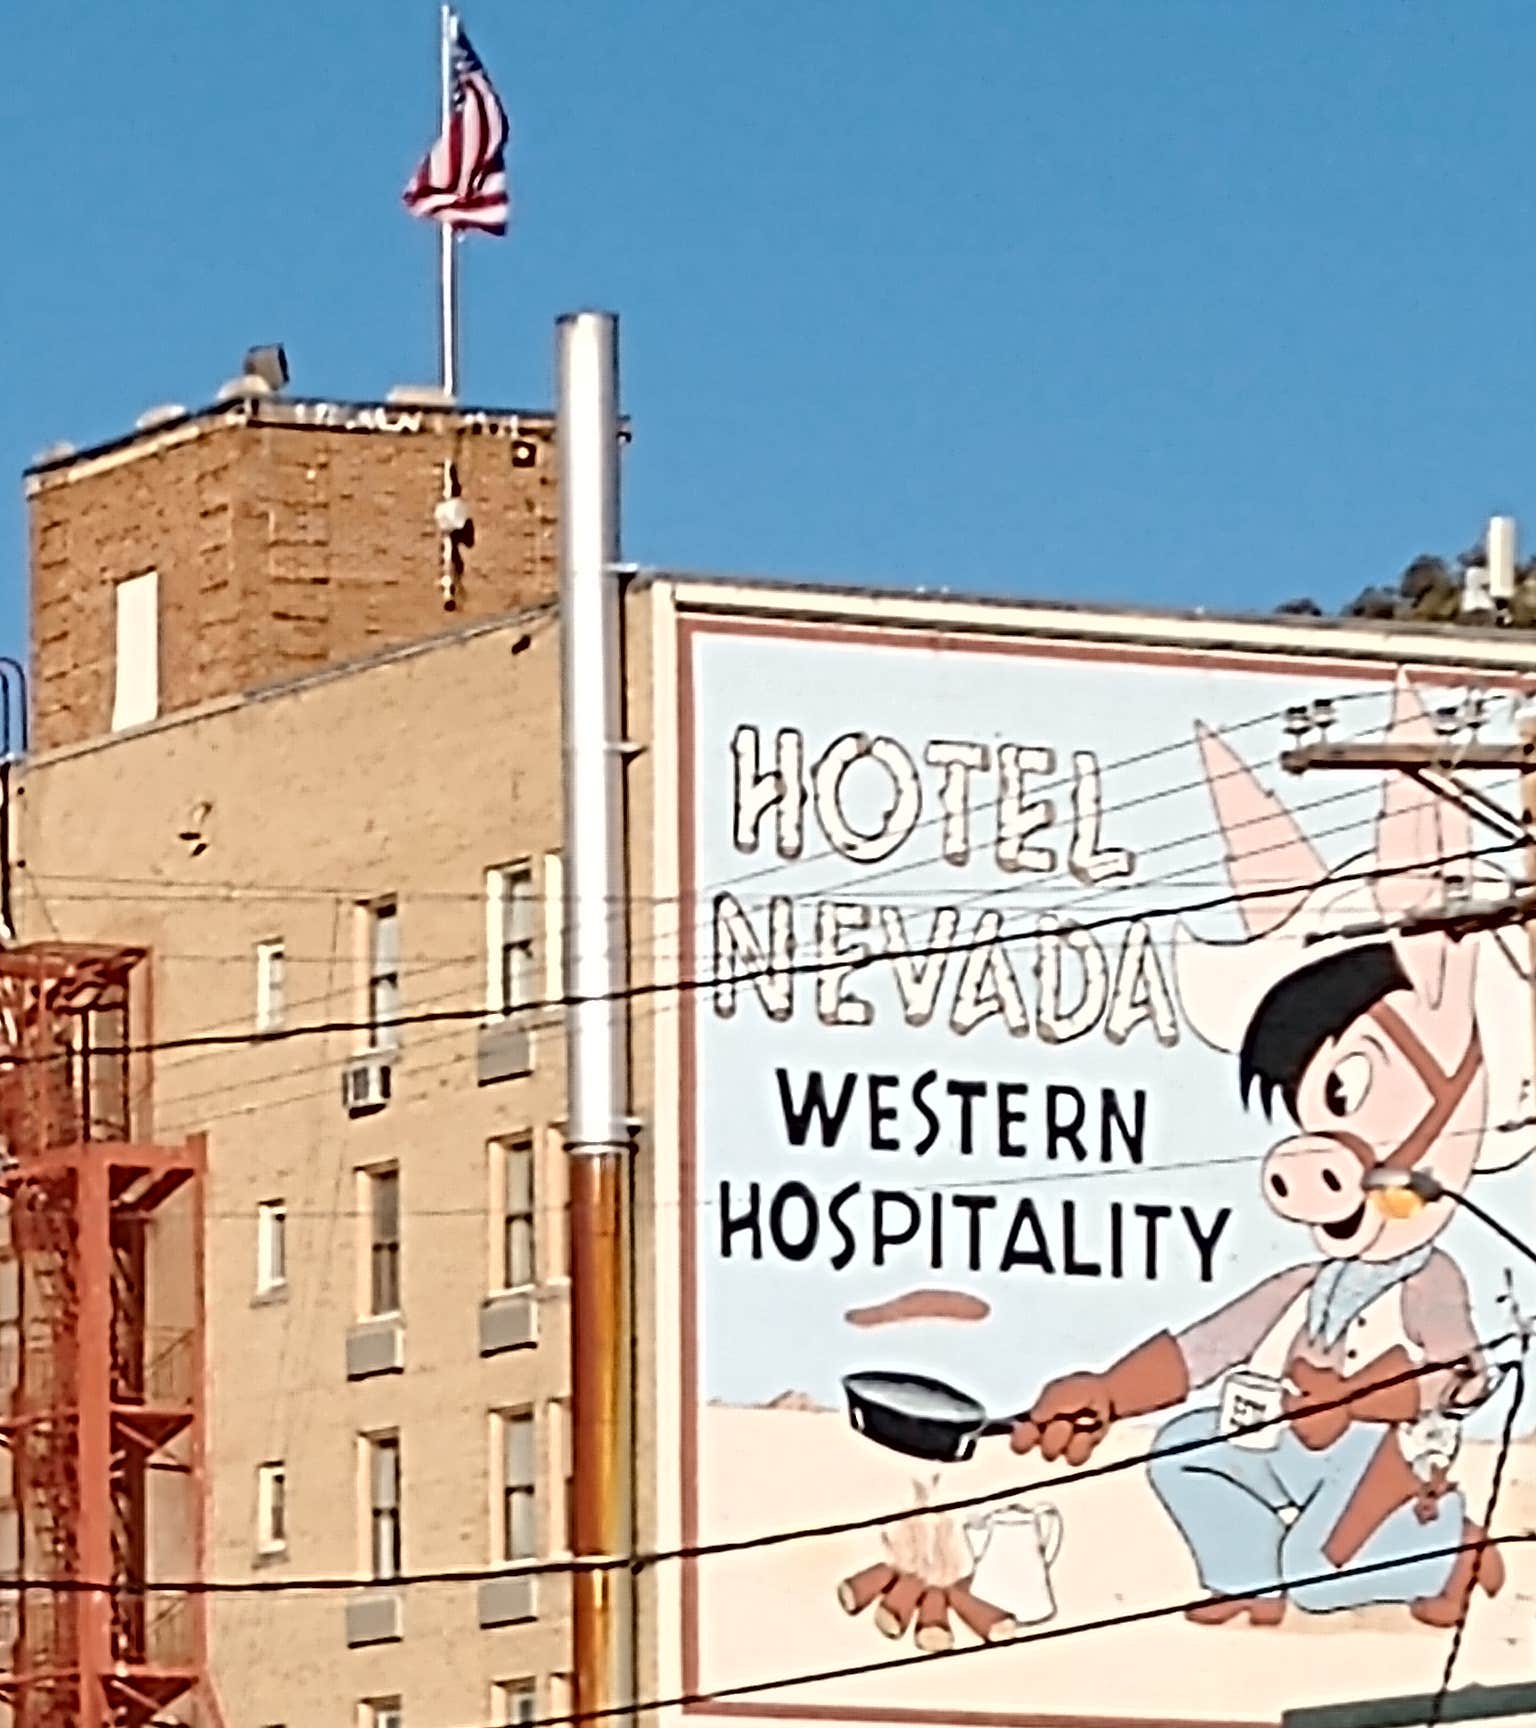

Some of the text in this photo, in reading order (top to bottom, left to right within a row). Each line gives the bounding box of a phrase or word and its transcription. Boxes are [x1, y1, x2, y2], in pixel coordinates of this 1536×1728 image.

[730, 725, 1136, 885] HOTEL
[712, 891, 1180, 1048] NEVADA
[775, 1068, 1148, 1164] WESTERN
[719, 1180, 1232, 1282] HOSPITALITY
